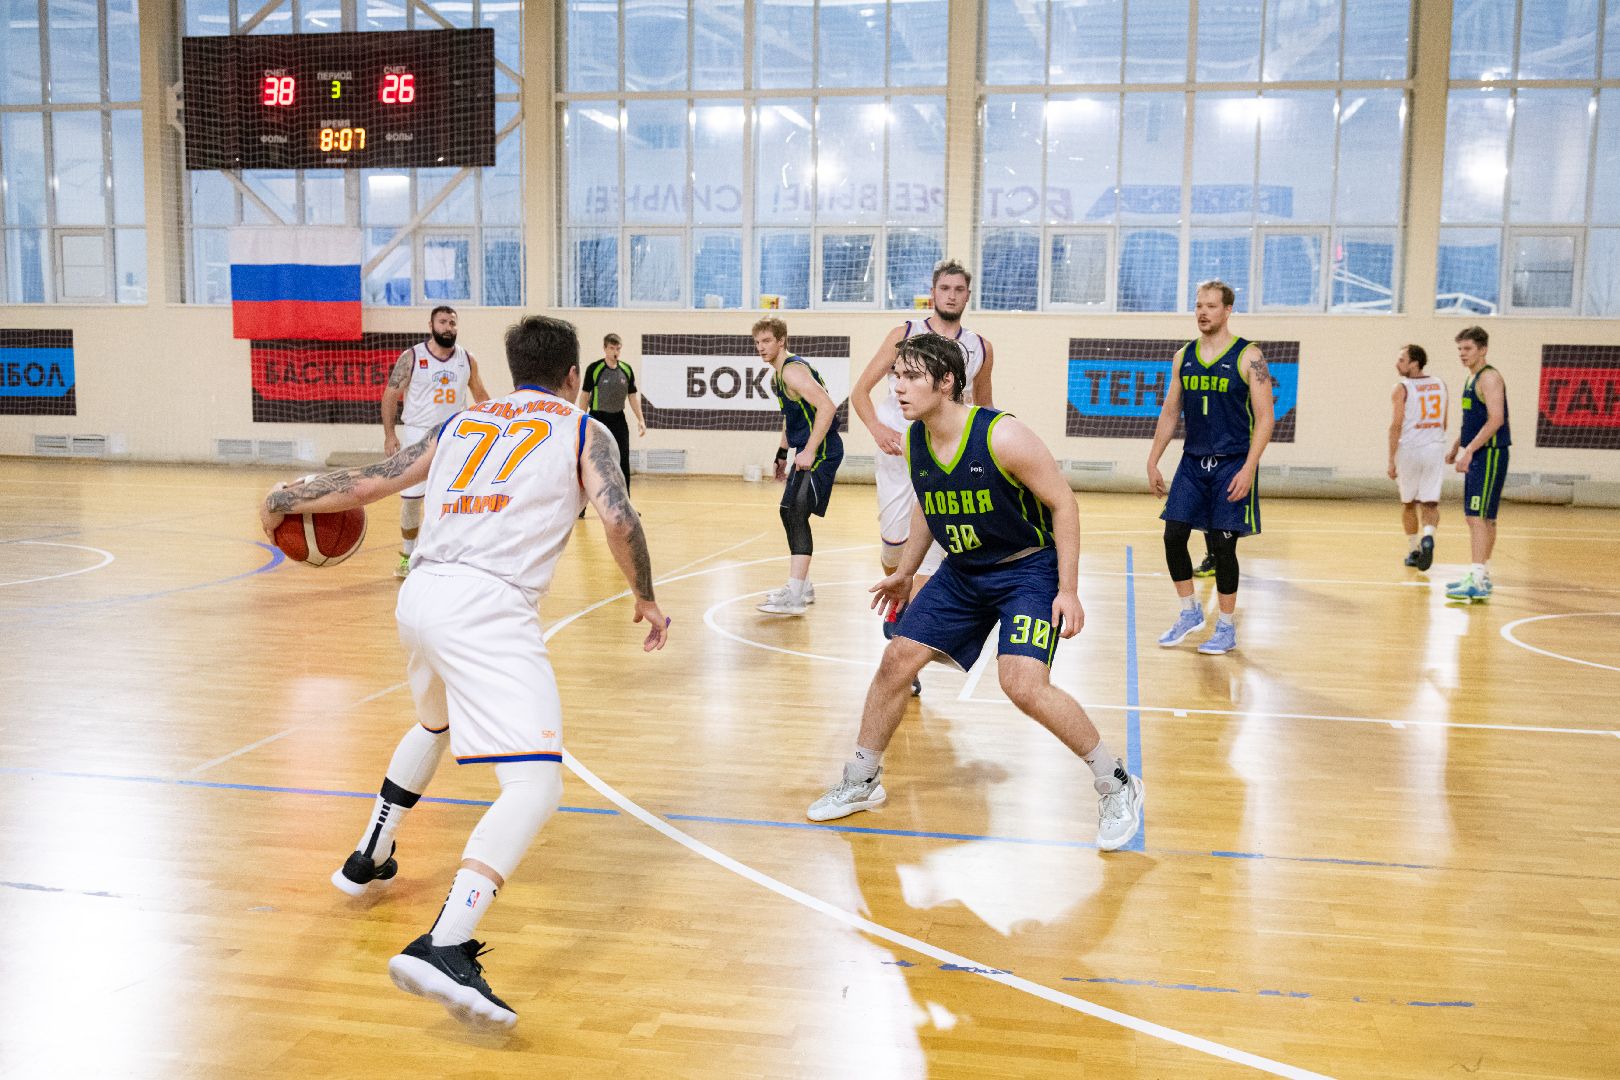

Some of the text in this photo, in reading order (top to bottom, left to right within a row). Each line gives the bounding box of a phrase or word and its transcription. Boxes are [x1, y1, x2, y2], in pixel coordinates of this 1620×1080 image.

[317, 71, 352, 80] ПЕРИОД
[264, 77, 294, 106] 38
[331, 81, 341, 98] 3
[383, 74, 414, 103] 26
[320, 120, 351, 128] ВРЕМЯ
[261, 135, 288, 143] ФОЛЫ
[320, 128, 367, 151] 8:07
[385, 132, 414, 141] ФОЛЫ
[0, 362, 66, 387] БОЛ
[687, 366, 778, 399] БОК
[433, 388, 456, 404] 28
[1201, 395, 1209, 416] 1
[1418, 394, 1441, 420] 13
[447, 418, 552, 492] 77
[924, 489, 994, 514] ЛОБНЯ
[1470, 495, 1480, 510] 8
[1244, 505, 1250, 524] 1
[945, 524, 983, 554] 30
[1010, 614, 1050, 650] 30
